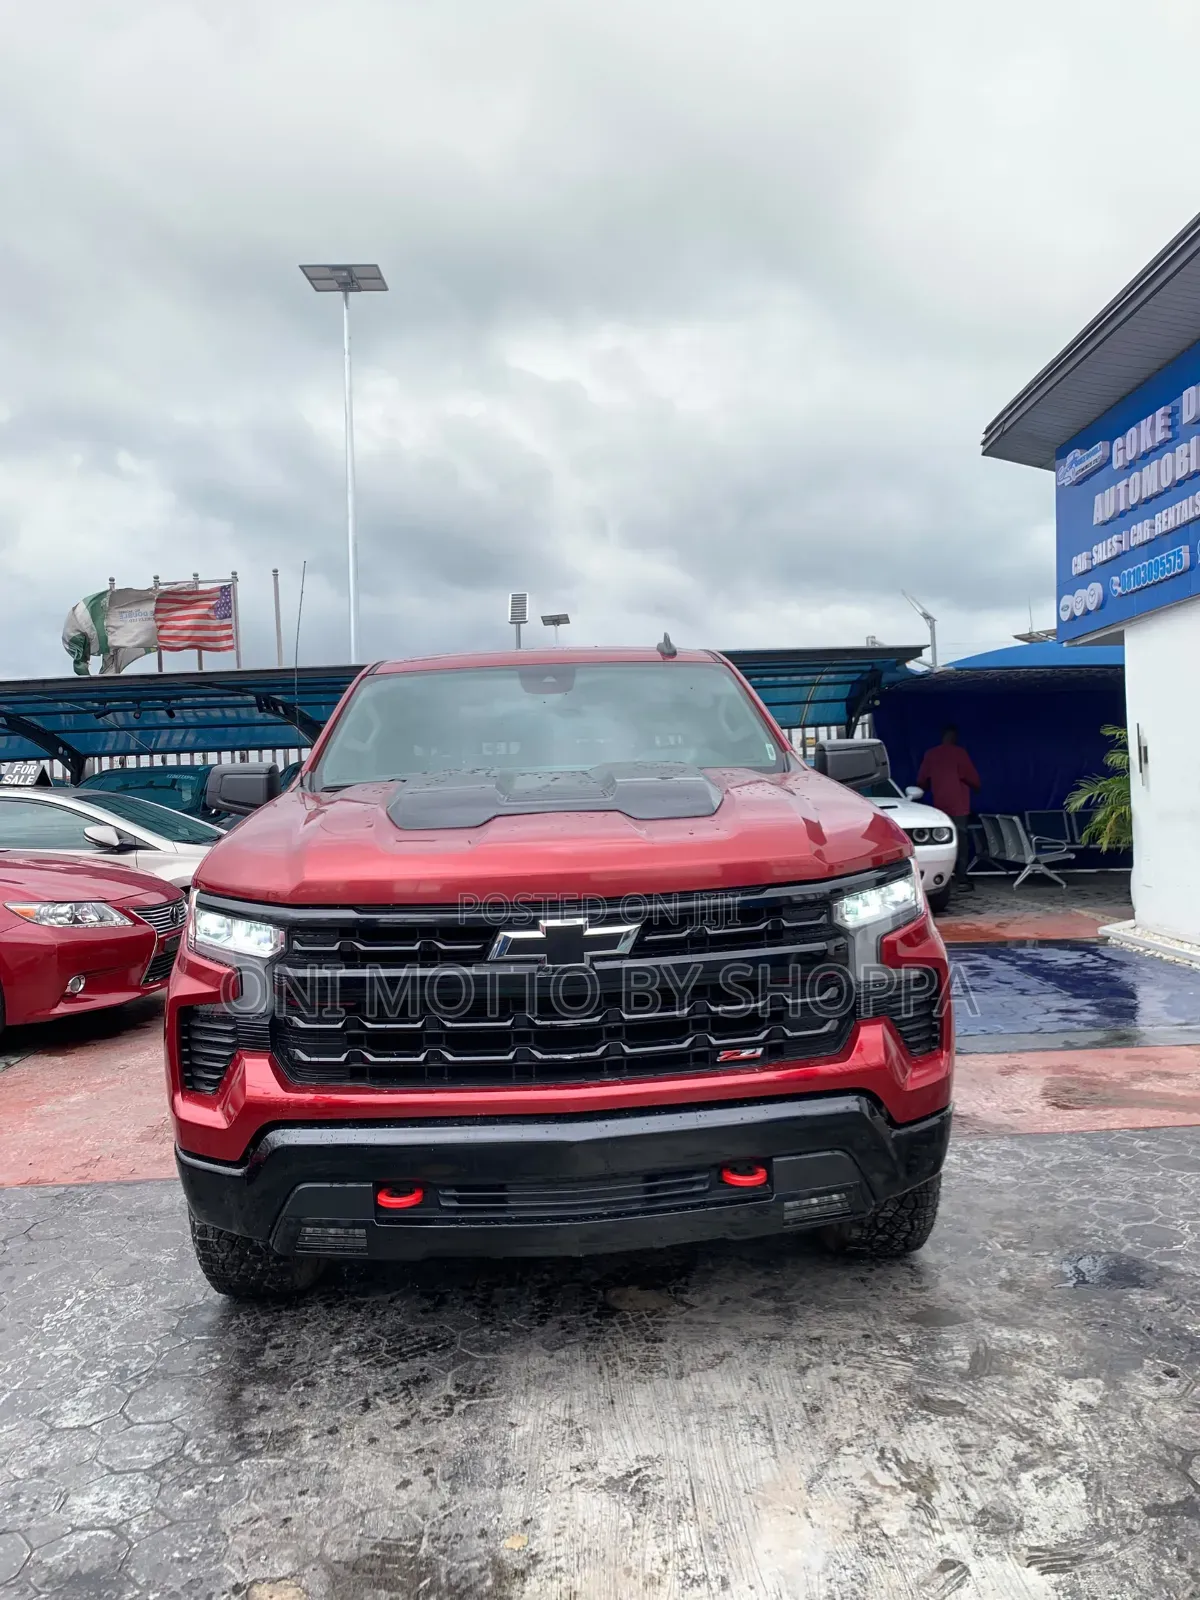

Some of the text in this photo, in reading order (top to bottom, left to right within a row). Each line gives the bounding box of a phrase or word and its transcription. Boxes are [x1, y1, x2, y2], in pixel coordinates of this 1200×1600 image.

[1112, 406, 1172, 470] GOKE
[1072, 551, 1092, 576] CAR
[1092, 534, 1123, 566] SALES
[1130, 519, 1155, 547] CAR
[1154, 490, 1200, 536] RENTALS
[1120, 547, 1185, 594] 08103095575
[2, 774, 35, 785] SALE
[13, 764, 37, 774] FOR
